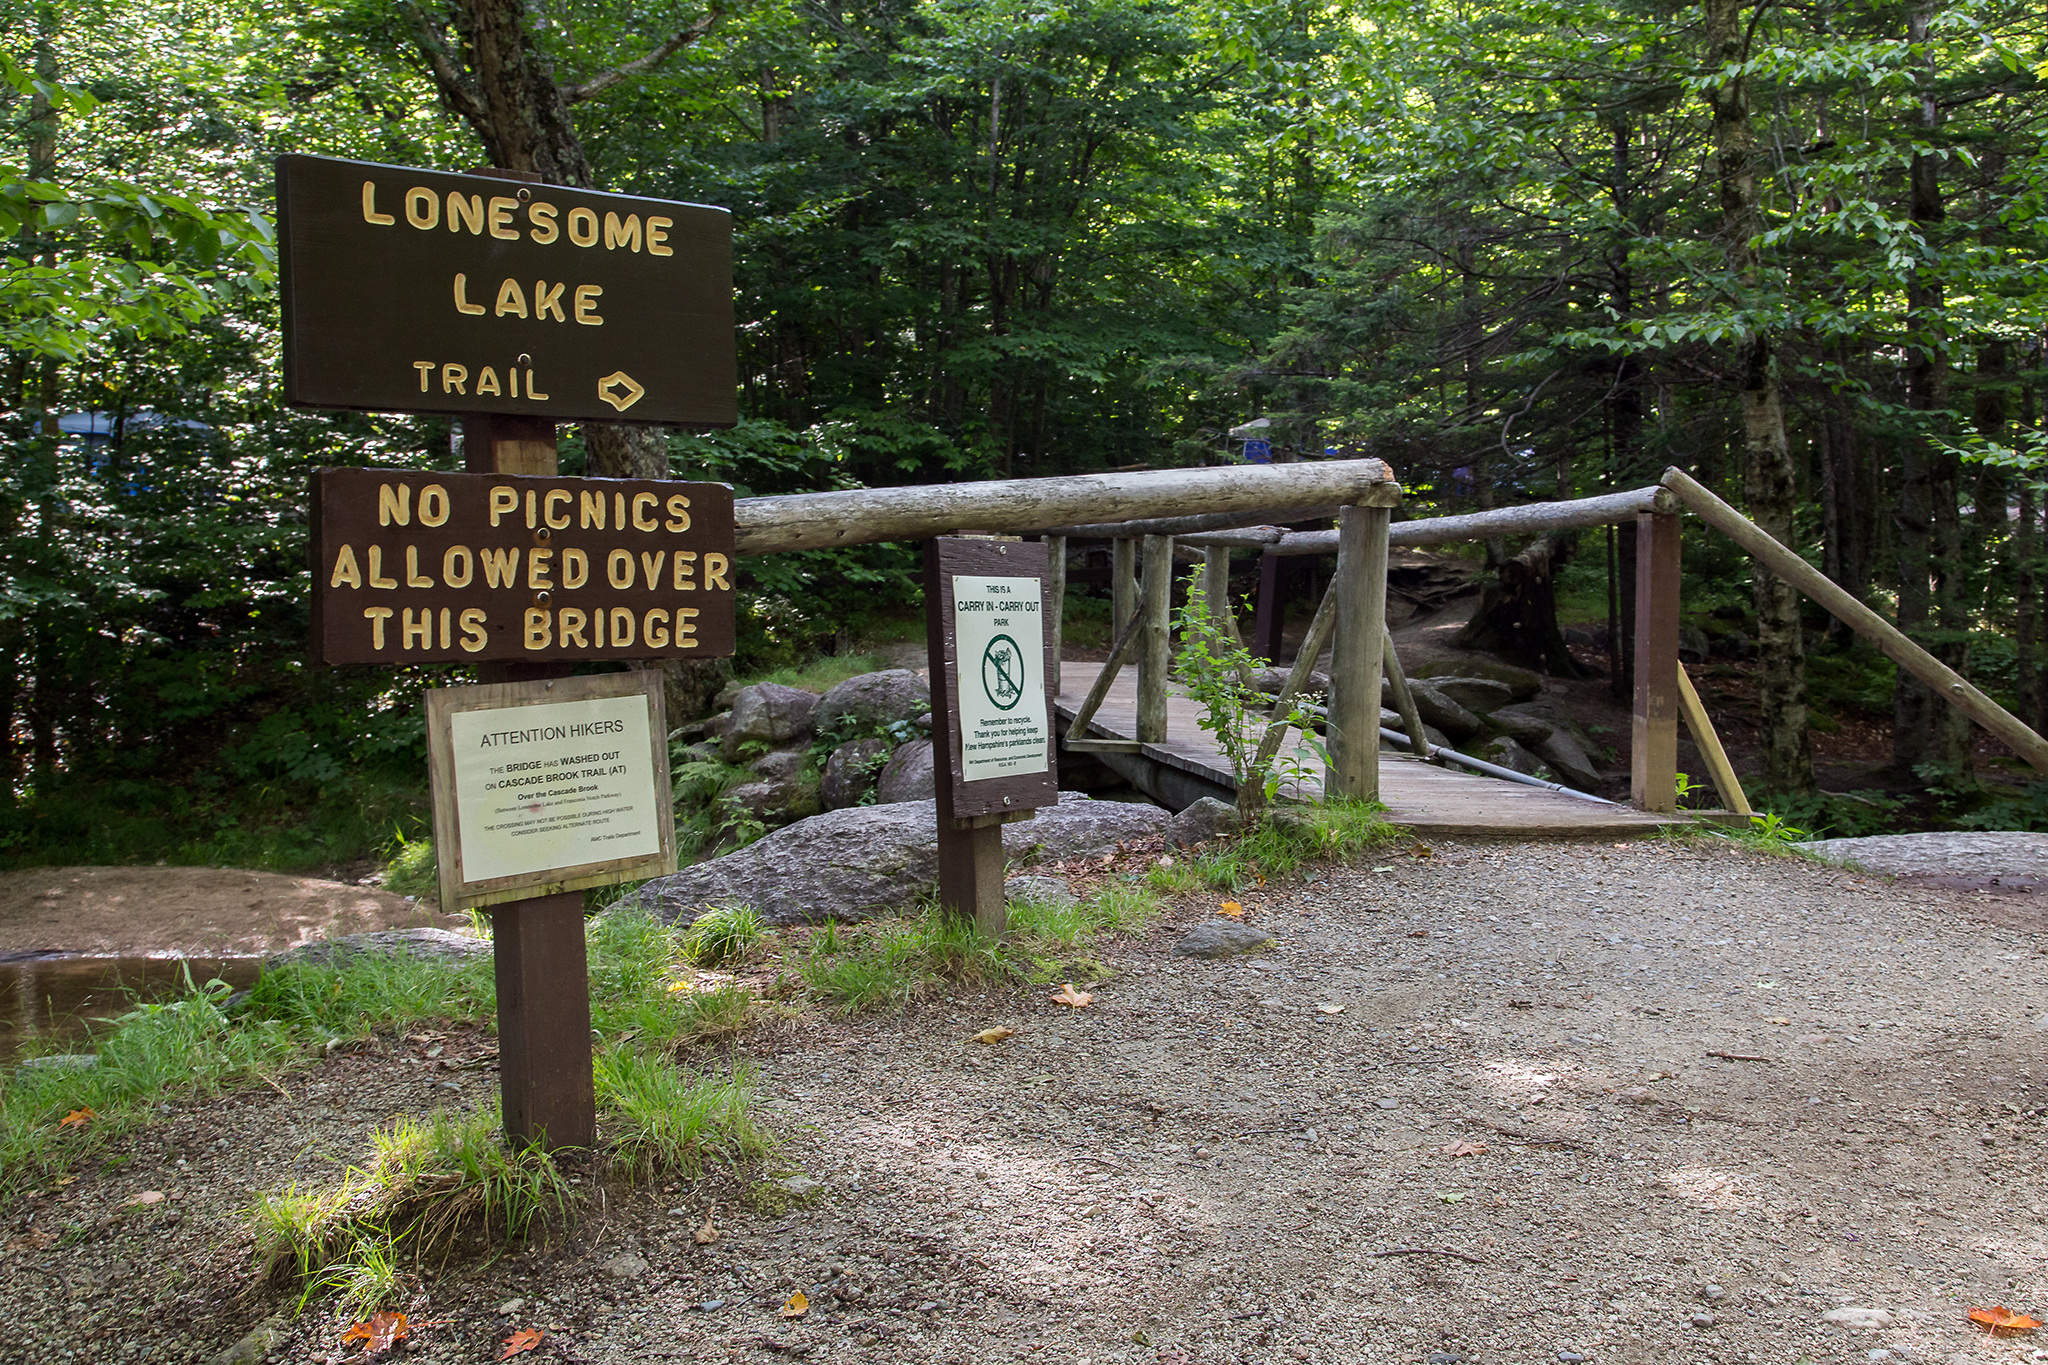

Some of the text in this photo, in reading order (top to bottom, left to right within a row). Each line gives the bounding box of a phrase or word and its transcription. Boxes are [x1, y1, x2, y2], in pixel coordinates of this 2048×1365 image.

[362, 180, 674, 257] LONESOME
[454, 272, 604, 326] LAKE
[413, 360, 549, 401] TRAIL
[378, 483, 691, 533] NO PICNICS
[330, 544, 730, 591] ALLOWED OVER
[986, 585, 1012, 594] THIS IS A
[957, 601, 985, 612] CARRY
[986, 601, 994, 612] IN
[999, 601, 1024, 612] CARRY
[1024, 601, 1040, 612] OUT
[364, 606, 700, 653] THIS BRIDGE
[993, 618, 1010, 627] PARK
[480, 719, 624, 748] ATTENTION HIKERS
[974, 730, 991, 739] Thank
[991, 731, 1000, 739] you
[1008, 727, 1027, 736] helping
[1027, 726, 1039, 735] keep
[980, 717, 1007, 727] Remember
[1007, 717, 1013, 725] to
[489, 751, 620, 775] THE BRIDGE HAS WASHED OUT
[485, 765, 627, 791] ON CASCADE BROOK TRAIL (AT)
[518, 784, 599, 801] Over the Cascade Brook
[496, 821, 524, 830] CROSSING
[556, 813, 581, 821] POSSIBLE
[582, 810, 602, 818] DURING
